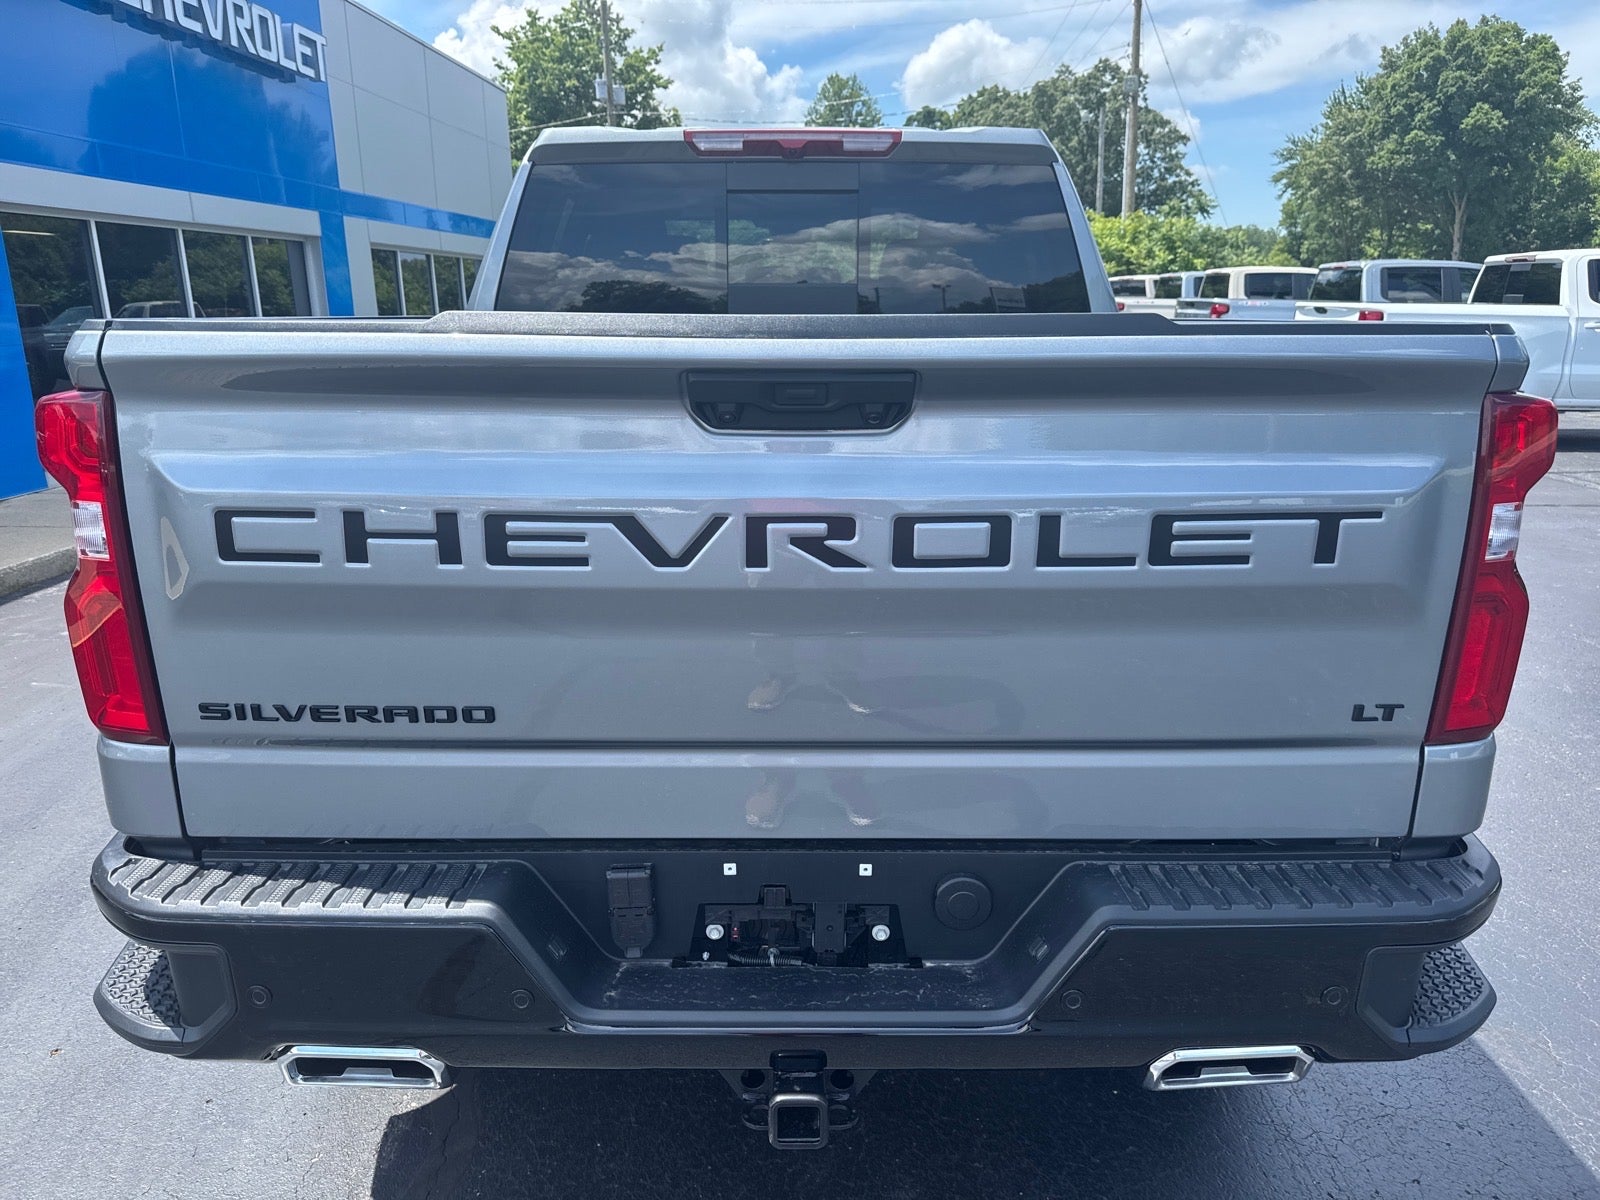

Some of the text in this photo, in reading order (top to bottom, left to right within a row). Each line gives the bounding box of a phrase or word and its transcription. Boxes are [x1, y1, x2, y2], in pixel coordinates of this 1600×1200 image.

[214, 509, 1384, 569] CHEVROLET
[198, 702, 496, 724] SILVERADO
[1351, 703, 1405, 722] LT
